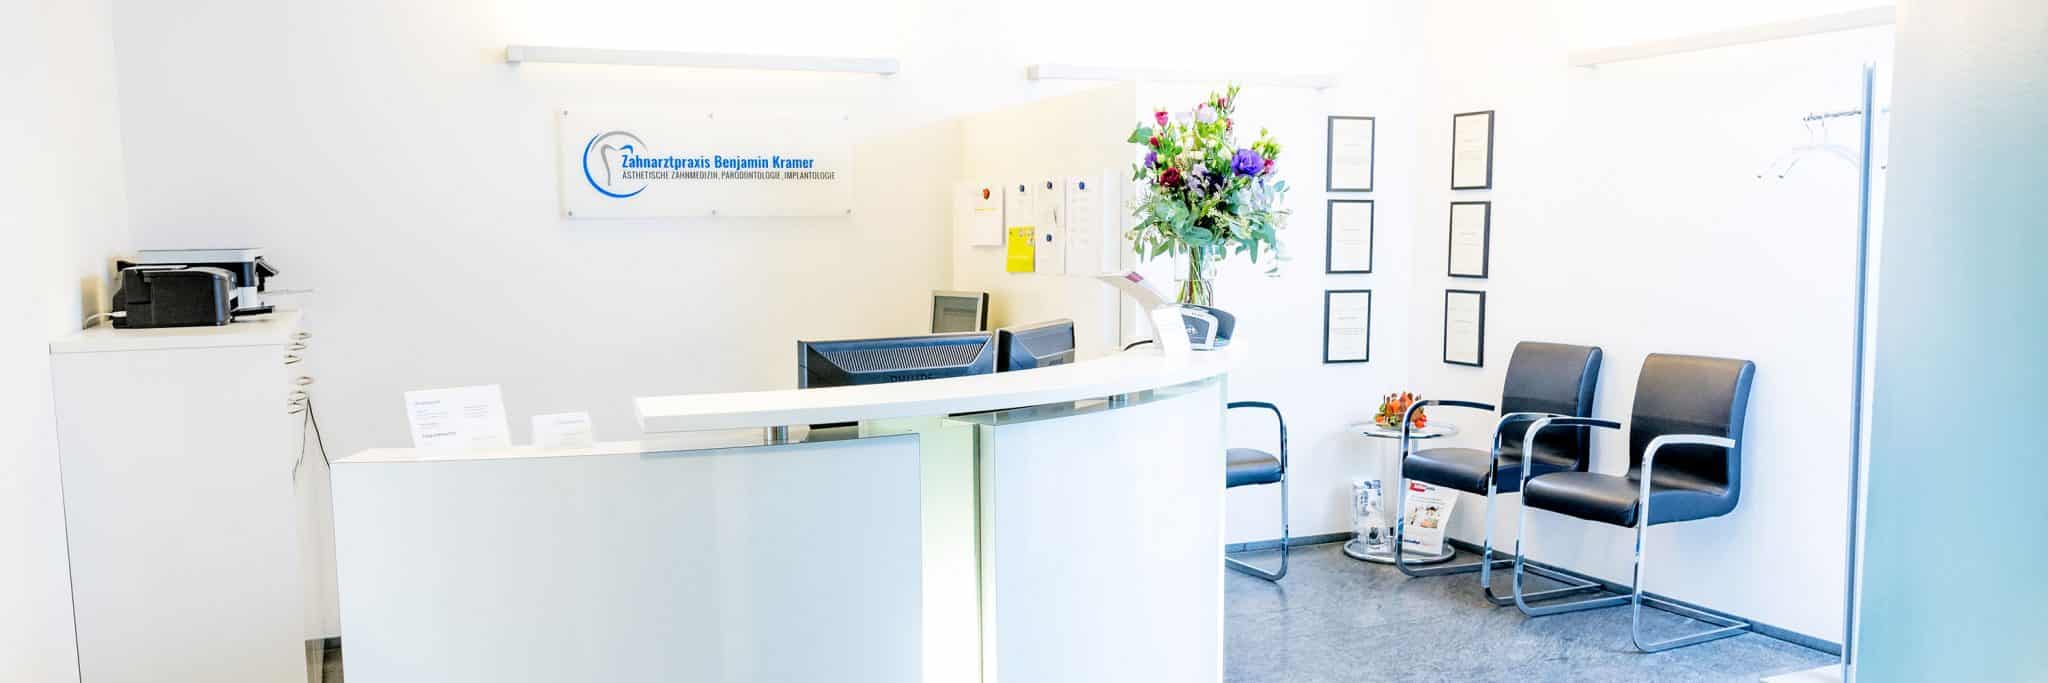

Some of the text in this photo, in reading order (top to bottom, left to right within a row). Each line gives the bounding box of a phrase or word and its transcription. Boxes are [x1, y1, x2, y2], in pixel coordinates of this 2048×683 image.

[621, 154, 814, 170] Zahnarztpraxis Benjamin Kramer
[784, 170, 836, 180] IMPLANTOLOGIE
